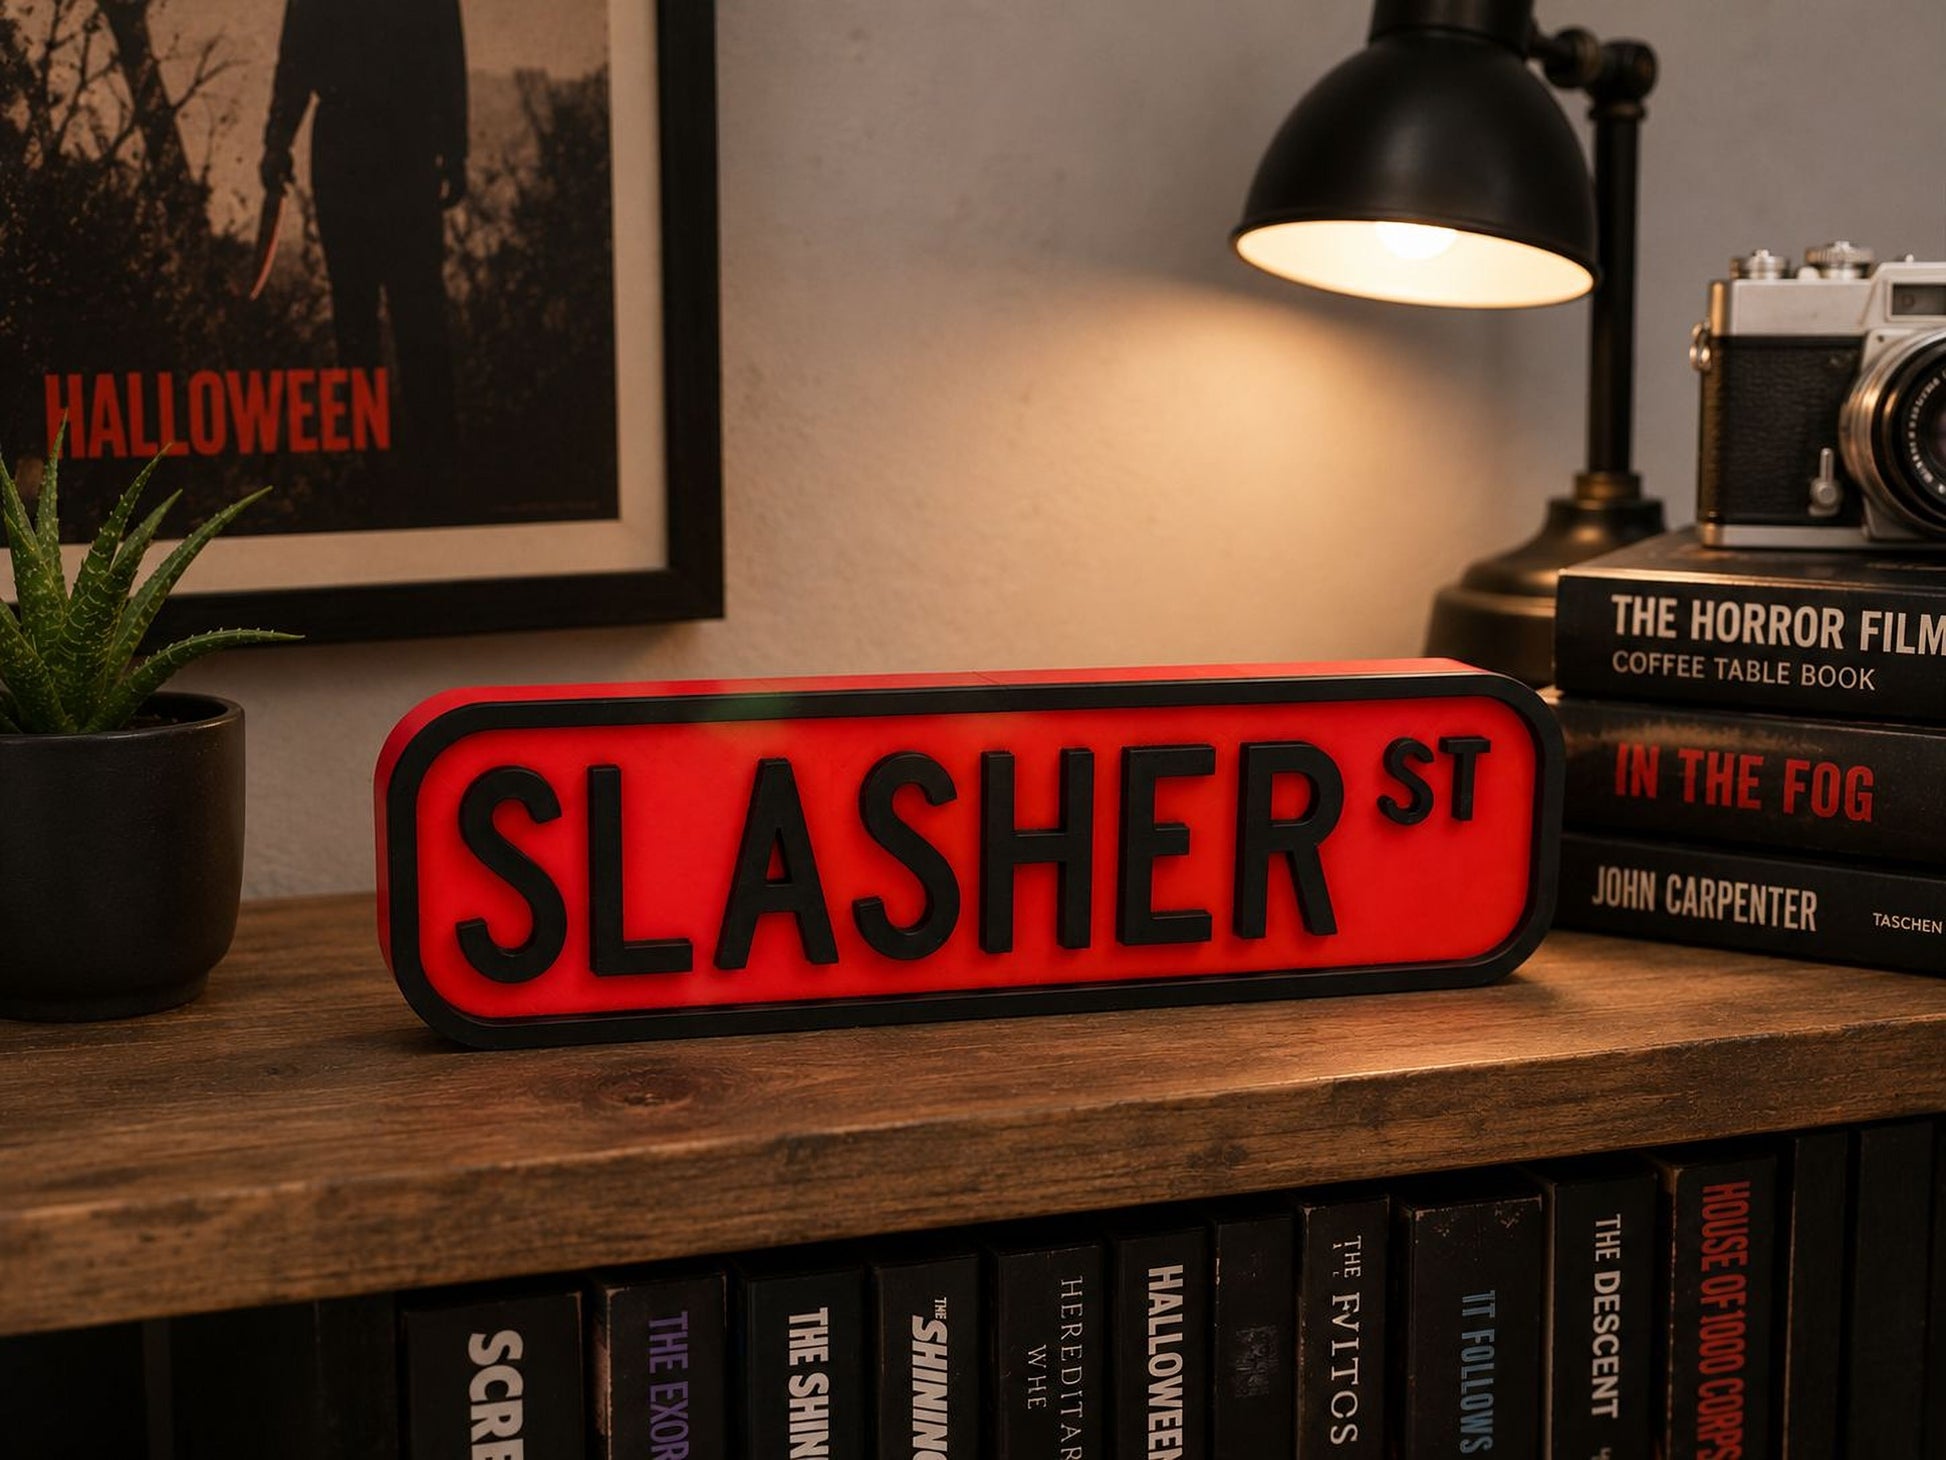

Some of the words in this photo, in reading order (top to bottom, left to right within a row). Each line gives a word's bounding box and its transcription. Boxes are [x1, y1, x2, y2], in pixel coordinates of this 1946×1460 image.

[45, 369, 389, 457] HALLOWEEN
[1611, 594, 1678, 638] THE
[1690, 599, 1845, 650] HORROR
[1859, 610, 1946, 656] FILM
[1612, 650, 1705, 678] COFFEE
[1713, 657, 1791, 685] TABLE
[1801, 663, 1875, 691] BOOK
[1616, 741, 1660, 797] IN
[1677, 748, 1764, 808] THE
[1783, 758, 1874, 821] FOG
[456, 740, 1344, 984] SLASHER
[1376, 736, 1491, 826] ST
[1592, 866, 1656, 911] JOHN
[1665, 873, 1818, 932] CARPENTER
[1872, 912, 1943, 935] TASCHEN
[1343, 1234, 1362, 1279] THE
[1595, 1213, 1621, 1262] THE
[1701, 1183, 1748, 1271] HOUSE
[934, 1296, 947, 1320] THE
[1701, 1274, 1746, 1305] OF
[649, 1311, 689, 1373] THE
[788, 1306, 829, 1366] THE
[1060, 1275, 1083, 1460] HEREDITAR
[1591, 1270, 1621, 1419] DESCENT
[1699, 1310, 1745, 1374] 1000
[1027, 1343, 1047, 1410] WHE
[1460, 1329, 1495, 1453] FOLLOWS
[788, 1372, 830, 1460] SHIN
